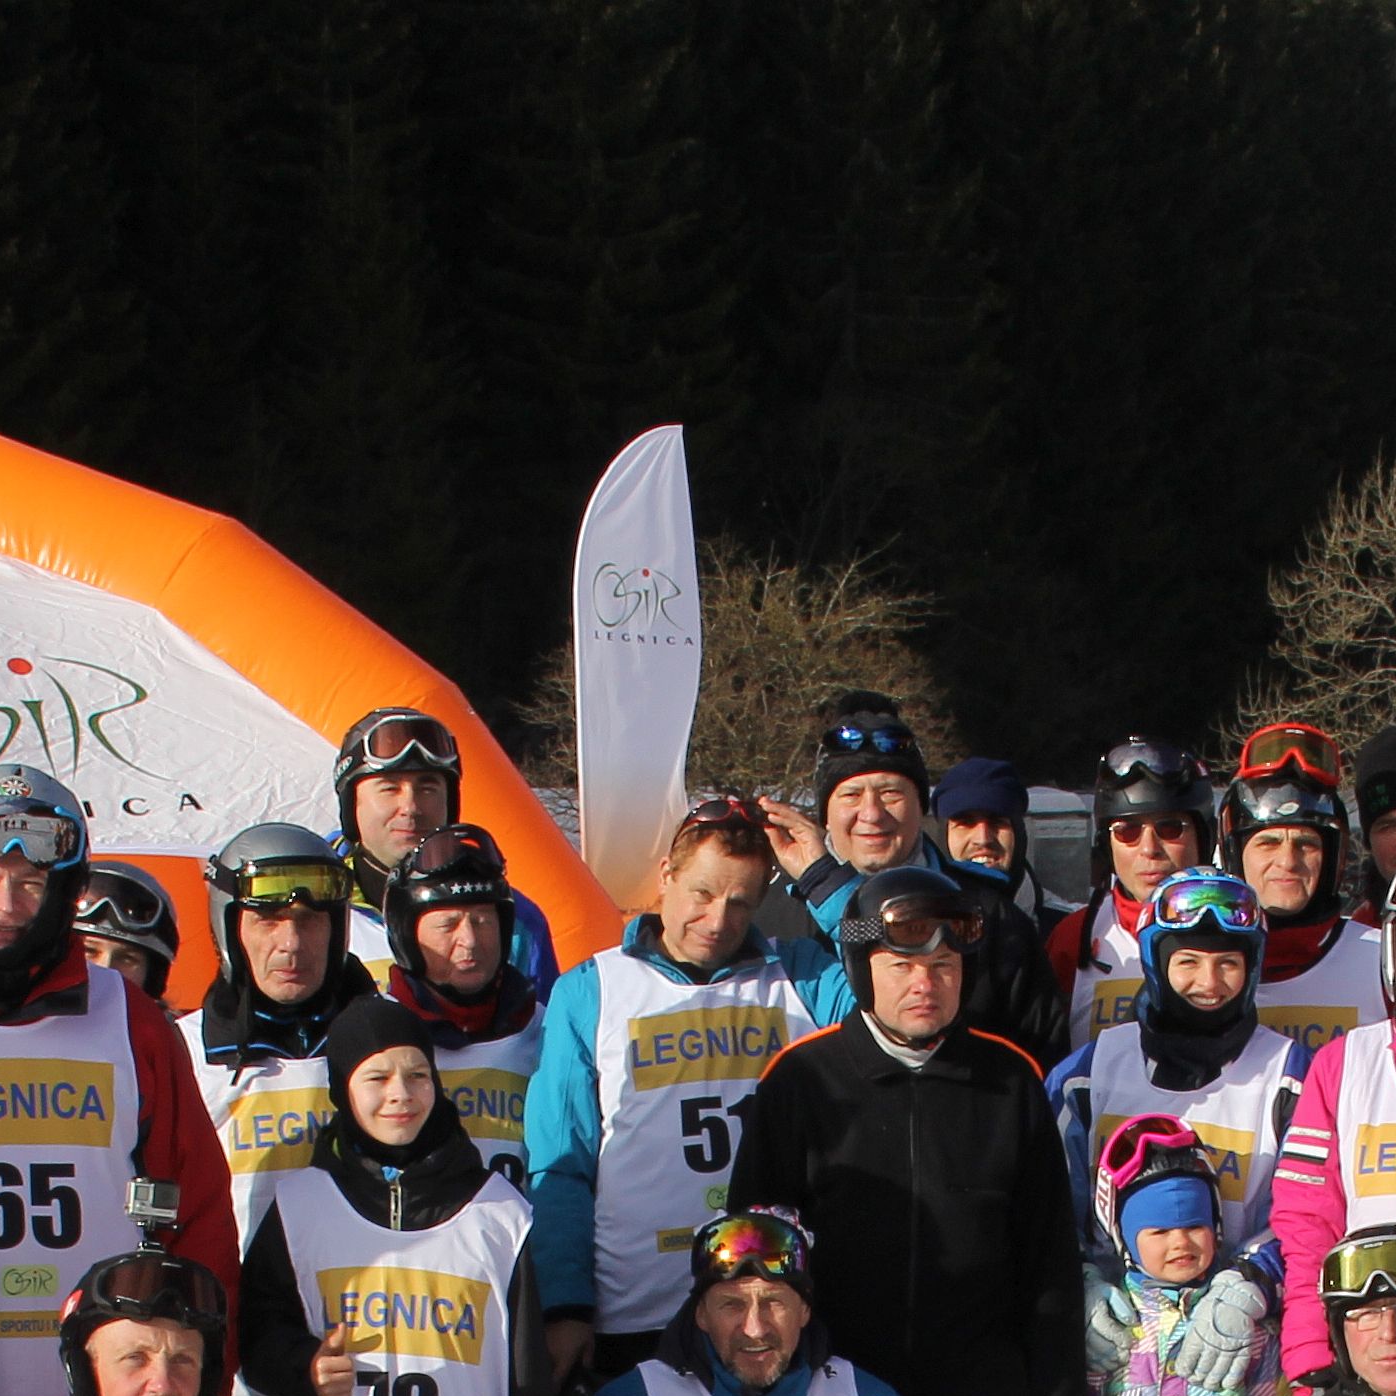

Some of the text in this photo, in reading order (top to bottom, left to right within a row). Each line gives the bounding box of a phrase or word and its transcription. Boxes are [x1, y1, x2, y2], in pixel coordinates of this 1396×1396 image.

[595, 631, 693, 646] LEGNICA
[632, 1026, 783, 1068] LEGNICA
[232, 1110, 337, 1151] LEGN
[322, 1292, 477, 1340] LEGNICA
